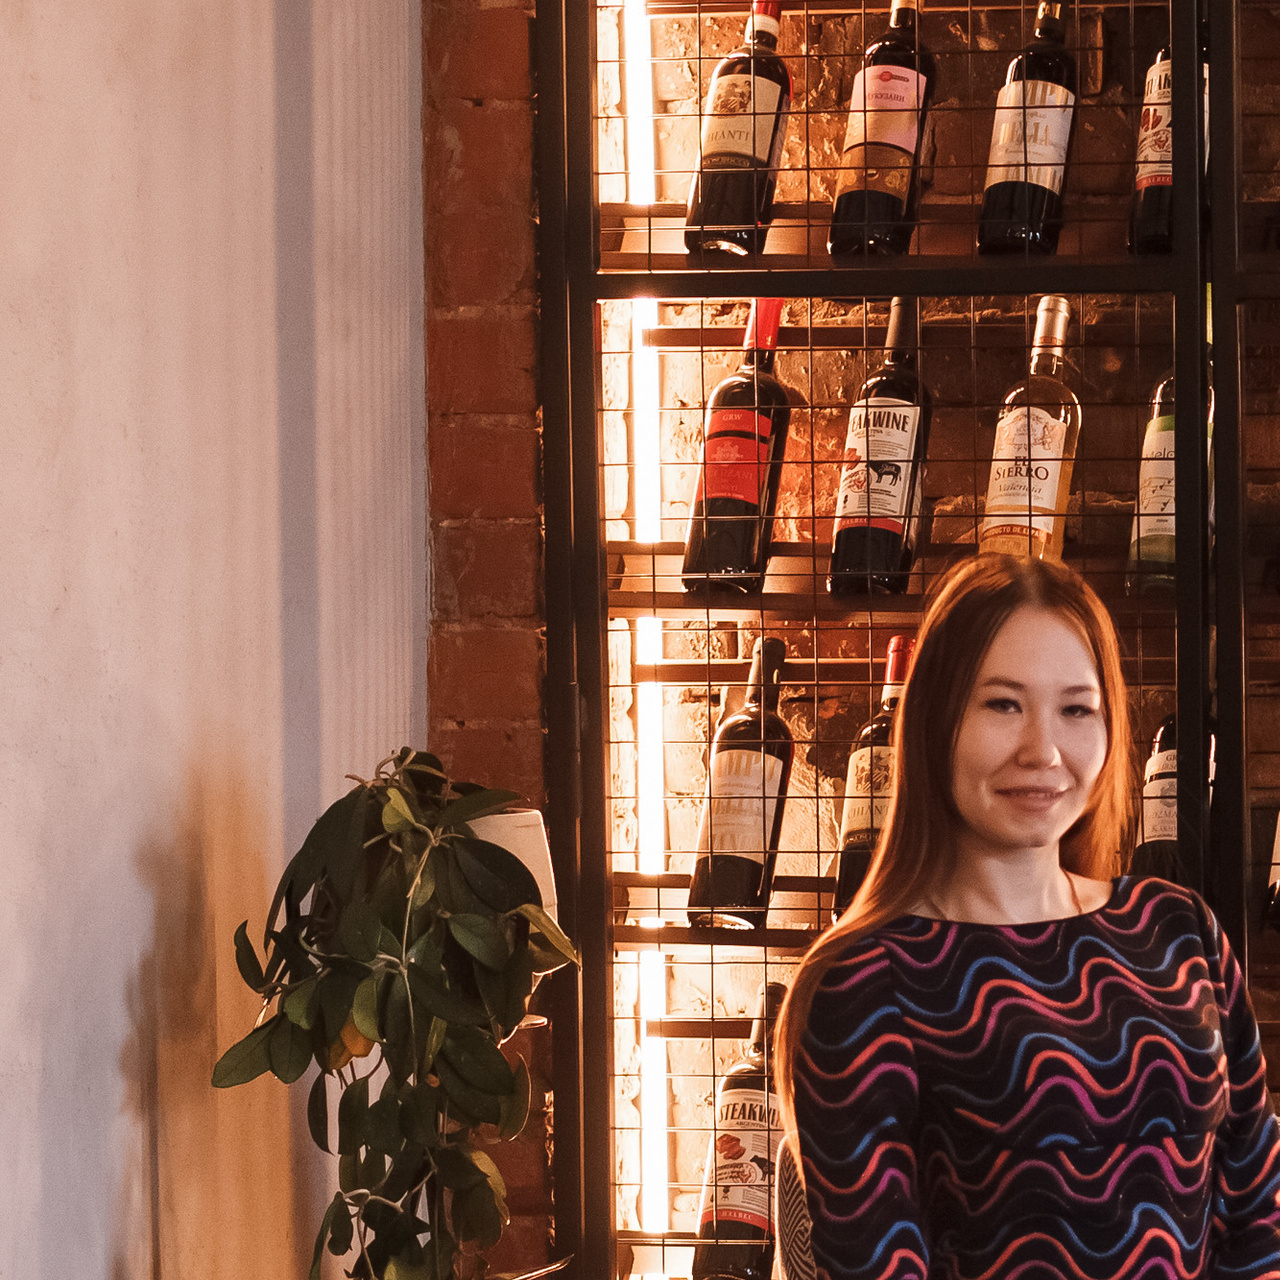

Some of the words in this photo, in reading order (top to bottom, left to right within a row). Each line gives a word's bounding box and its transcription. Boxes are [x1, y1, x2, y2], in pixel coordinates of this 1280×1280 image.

[994, 466, 1050, 482] SIERRO
[847, 804, 890, 821] CHIANT
[718, 1101, 781, 1129] STEAKWI
